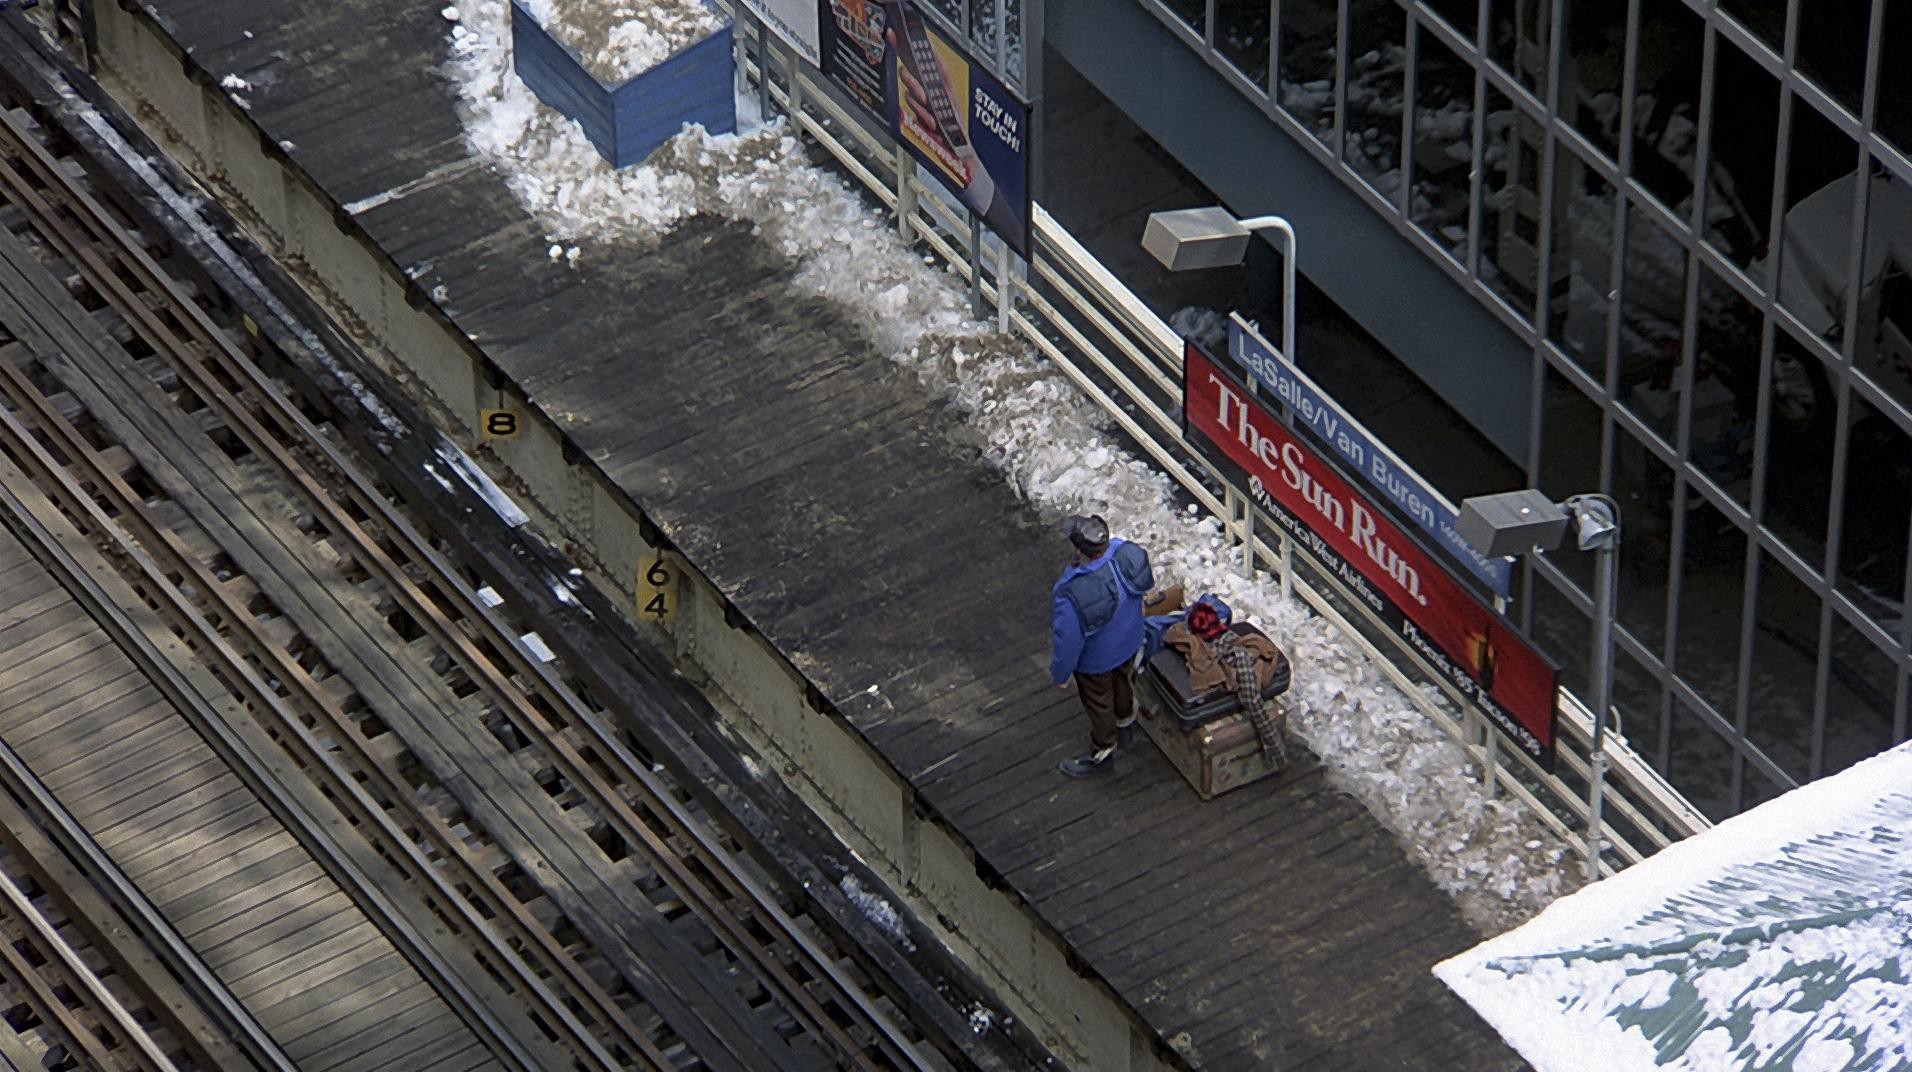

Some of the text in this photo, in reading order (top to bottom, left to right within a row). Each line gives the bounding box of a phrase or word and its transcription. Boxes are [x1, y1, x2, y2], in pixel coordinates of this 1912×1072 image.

[974, 87, 1018, 132] STAY IN
[974, 103, 1021, 153] TOUCH!
[487, 412, 517, 436] 8
[1238, 332, 1364, 467] LaSalle/Van
[1371, 454, 1435, 529] Buren
[1208, 372, 1427, 607] The Sun Run.
[646, 559, 670, 587] 6
[1262, 494, 1384, 612] America West Airlines
[644, 592, 669, 619] 4
[1403, 618, 1451, 675] Phoenix
